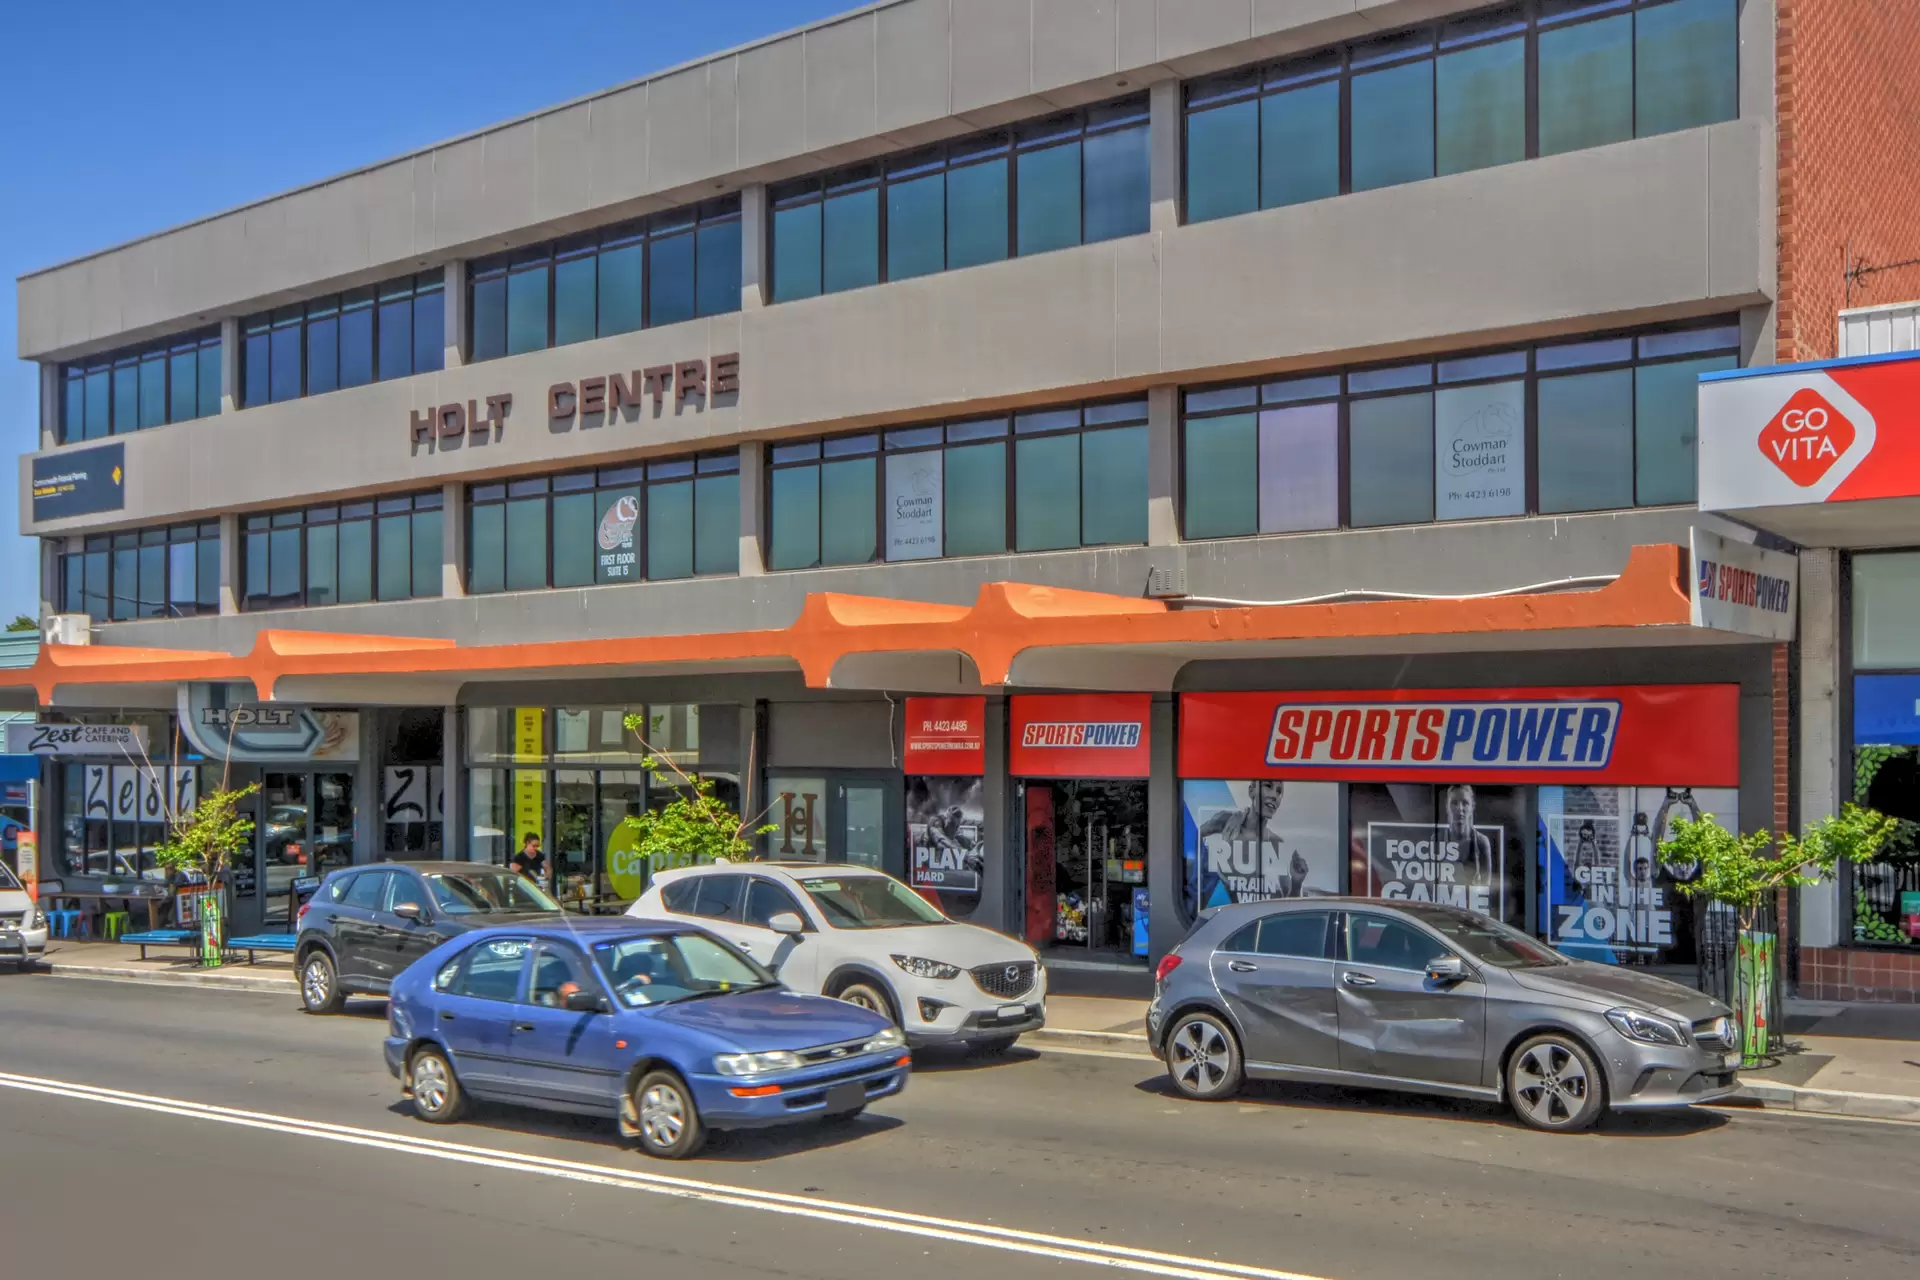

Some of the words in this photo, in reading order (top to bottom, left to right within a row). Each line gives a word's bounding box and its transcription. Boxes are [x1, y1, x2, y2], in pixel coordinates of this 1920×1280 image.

[410, 393, 513, 442] HOLT
[547, 351, 740, 421] CENTRE
[1782, 407, 1829, 433] GO
[1452, 438, 1507, 453] Cowman
[1771, 436, 1838, 462] VITA
[1452, 453, 1506, 469] Stoddart
[896, 495, 933, 508] Cowman
[1488, 487, 1512, 498] 6198
[896, 507, 933, 520] Stoddart
[600, 554, 616, 566] FIRST
[616, 552, 636, 565] FLOOR
[607, 566, 622, 577] SUITE
[1719, 564, 1790, 614] SPORTSPOWER
[202, 707, 296, 726] HOLT
[934, 720, 950, 732] 4423
[951, 720, 969, 732] 4495
[28, 725, 83, 752] Zest
[109, 726, 131, 735] AND
[85, 734, 130, 743] CATERING
[1024, 723, 1141, 747] SPORTSPOWER
[1274, 705, 1610, 763] SPORTSPOWER
[86, 767, 194, 817] Zest
[915, 847, 967, 870] PLAY
[1205, 833, 1289, 875] RUN
[1386, 839, 1460, 861] FOCUS
[916, 872, 945, 883] HARD
[1391, 860, 1456, 882] YOUR
[1575, 866, 1616, 884] GET
[1227, 876, 1277, 893] TRAIN
[1381, 881, 1490, 917] GAME
[1592, 885, 1613, 903] IN
[1619, 887, 1664, 907] THE
[1558, 905, 1673, 944] ZONE
